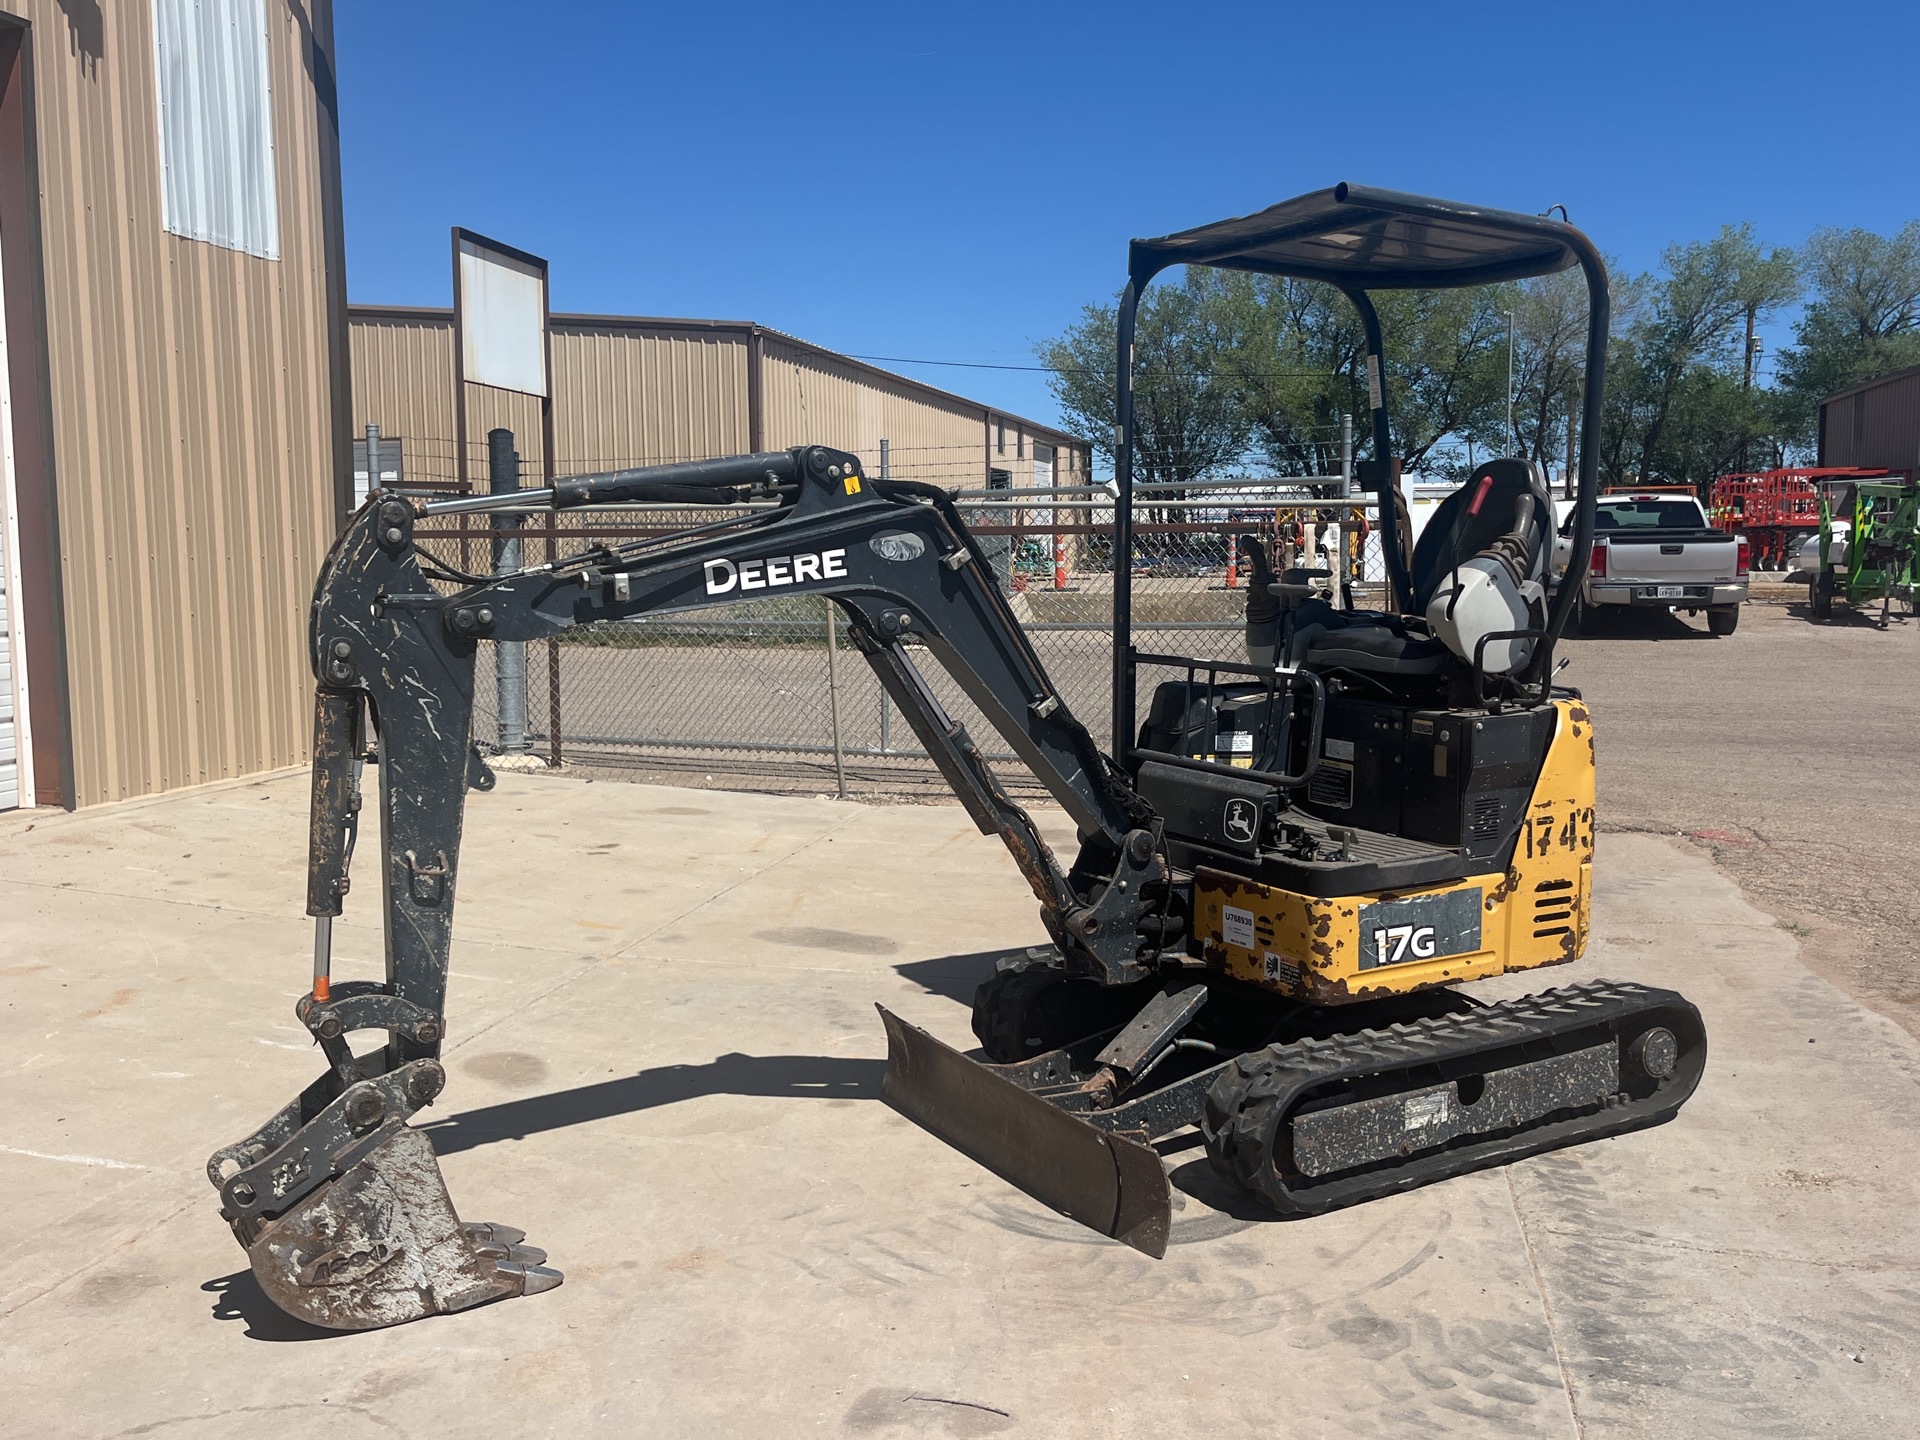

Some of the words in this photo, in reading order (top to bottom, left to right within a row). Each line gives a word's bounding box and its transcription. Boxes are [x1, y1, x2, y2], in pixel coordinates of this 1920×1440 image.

[703, 548, 848, 594] DEERE
[1524, 808, 1595, 859] 1743
[1225, 912, 1253, 926] U768930
[1374, 925, 1435, 964] 17G
